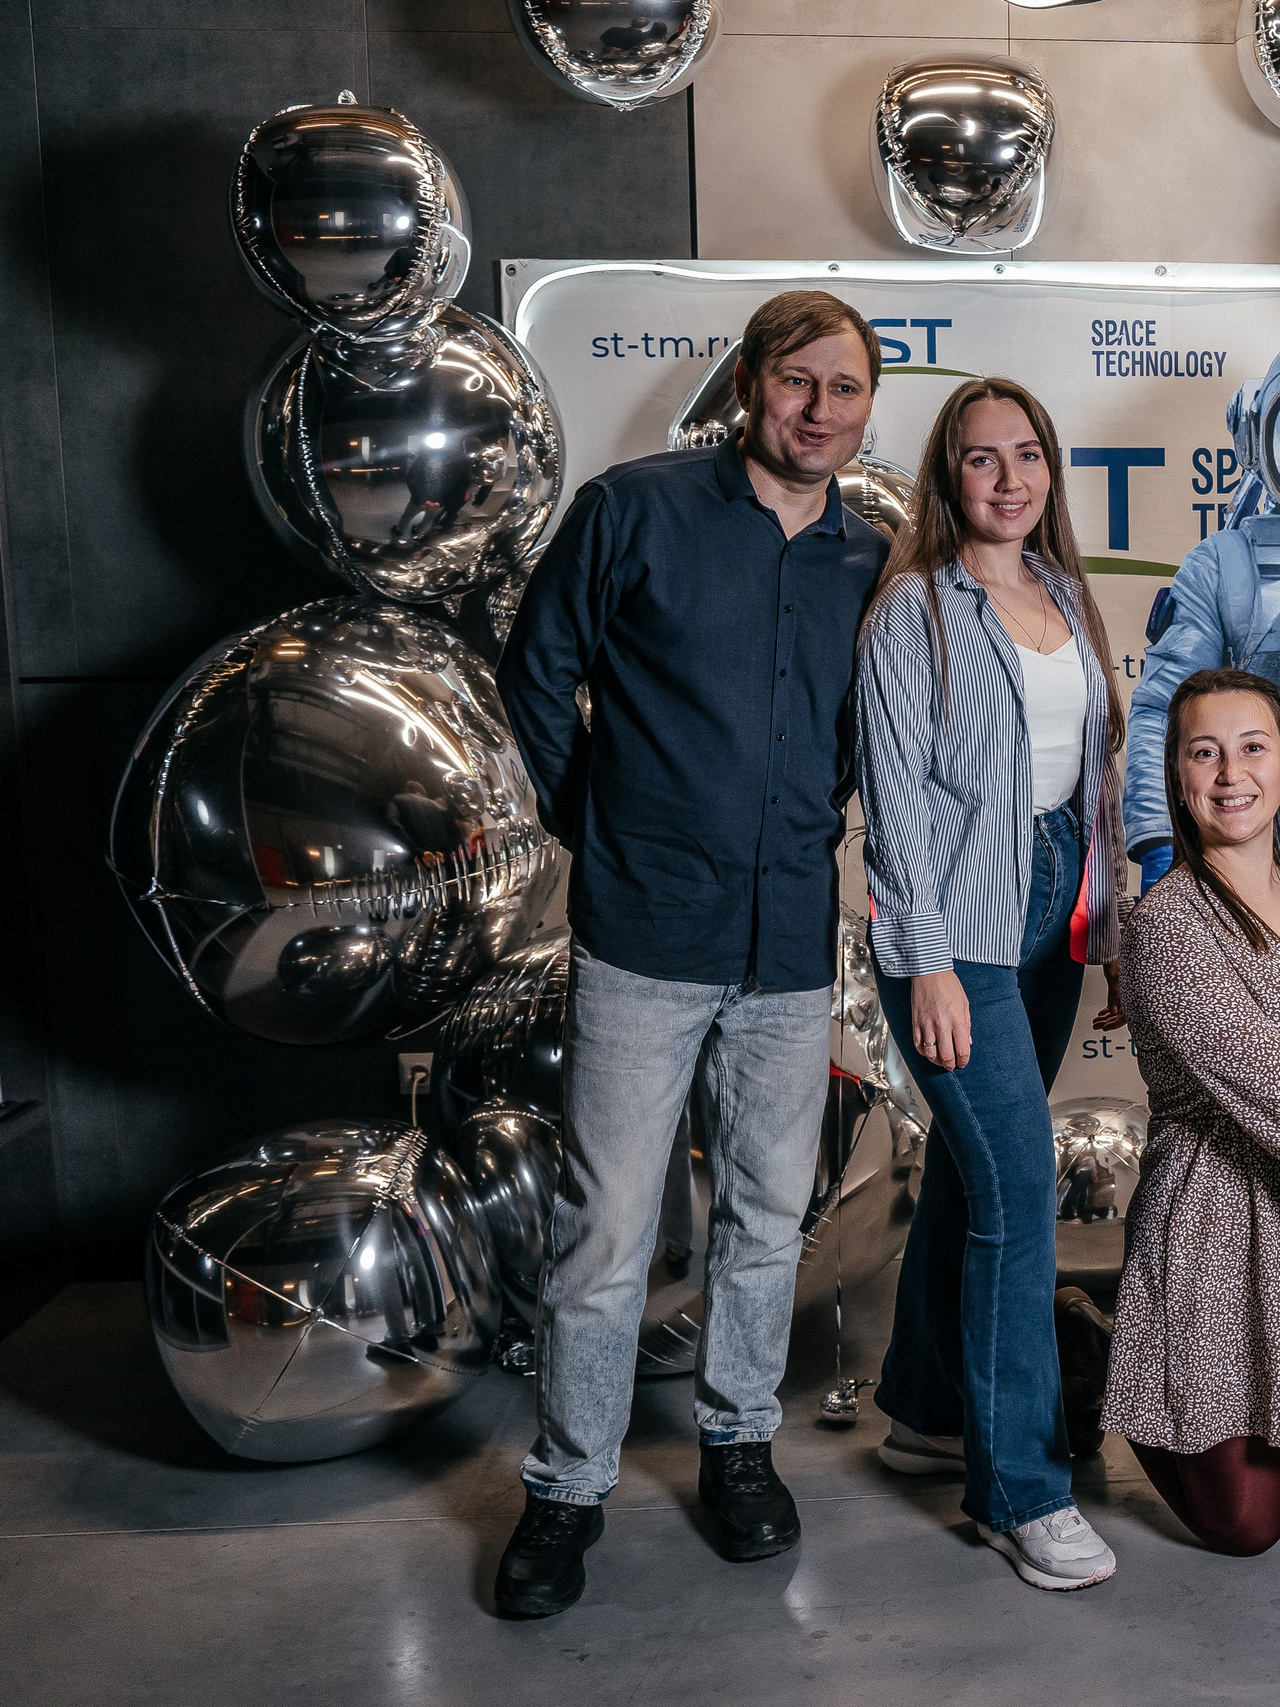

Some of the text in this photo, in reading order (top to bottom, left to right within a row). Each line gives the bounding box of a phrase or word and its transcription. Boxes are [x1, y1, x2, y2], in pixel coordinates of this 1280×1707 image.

[591, 332, 729, 358] st-tm.r
[867, 318, 953, 365] ST
[1091, 319, 1156, 346] SPACE
[1091, 350, 1227, 378] TECHNOLOGY
[1191, 447, 1245, 495] SP
[1059, 447, 1166, 551] T
[1082, 1035, 1139, 1060] st-t
